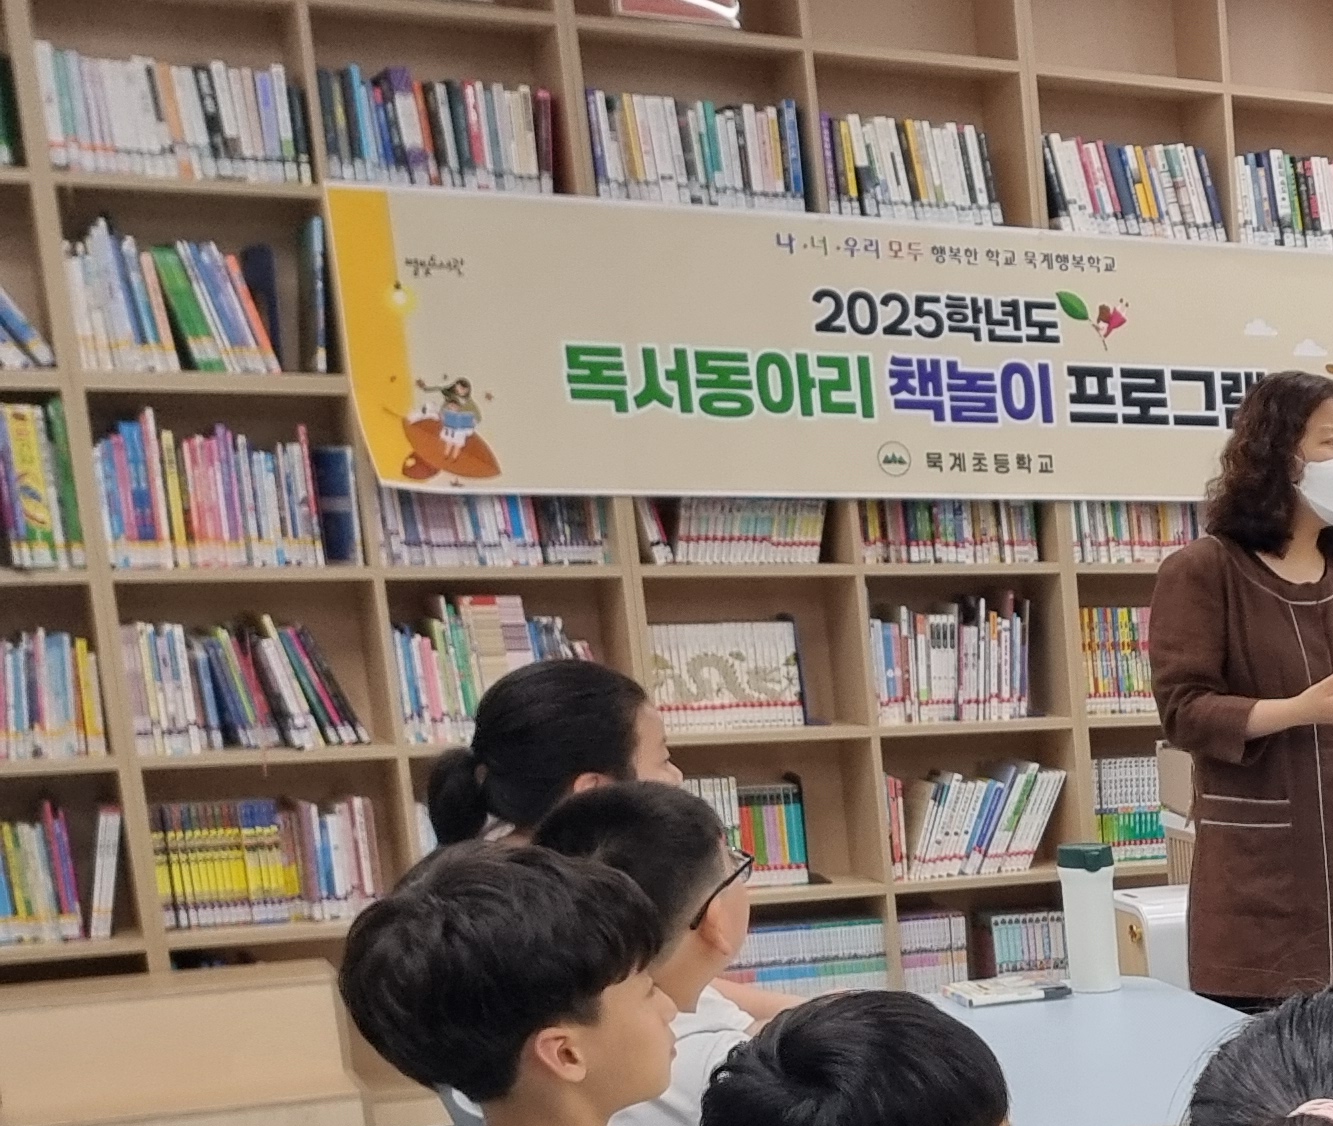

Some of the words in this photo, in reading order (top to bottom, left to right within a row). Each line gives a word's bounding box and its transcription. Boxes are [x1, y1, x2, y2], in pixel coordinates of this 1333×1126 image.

[888, 241, 924, 261] 모두
[931, 245, 979, 266] 행복한
[986, 248, 1017, 267] 학교
[812, 289, 1061, 343] 2025학년도
[565, 345, 876, 418] 독서동아리
[888, 355, 1054, 424] 책놀이
[926, 451, 1055, 474] 묵계초등학교
